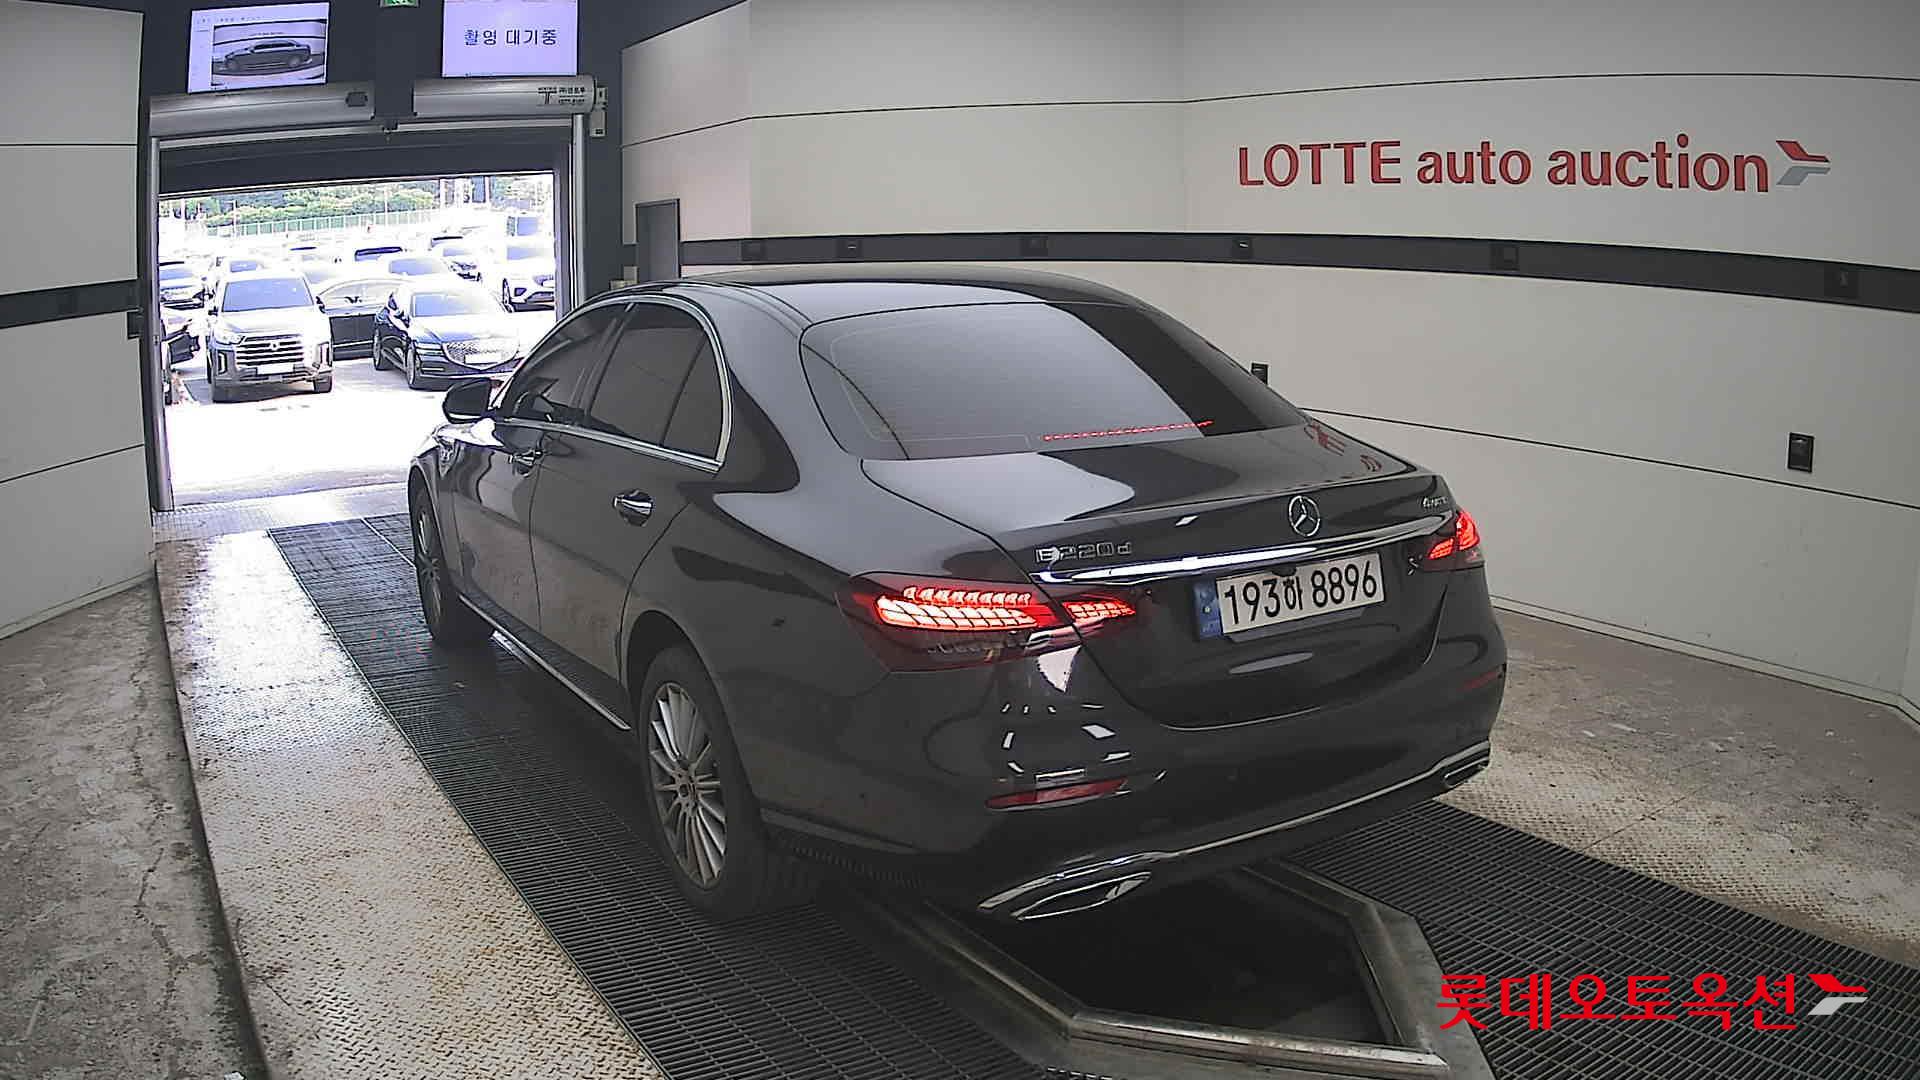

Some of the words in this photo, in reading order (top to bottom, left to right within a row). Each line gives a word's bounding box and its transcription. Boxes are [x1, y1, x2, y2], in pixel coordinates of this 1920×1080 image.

[506, 29, 557, 46] 대기중
[1238, 140, 1400, 187] LOTTE
[1416, 141, 1532, 187] auto
[1547, 133, 1770, 193] auction
[1310, 559, 1378, 608] 8896
